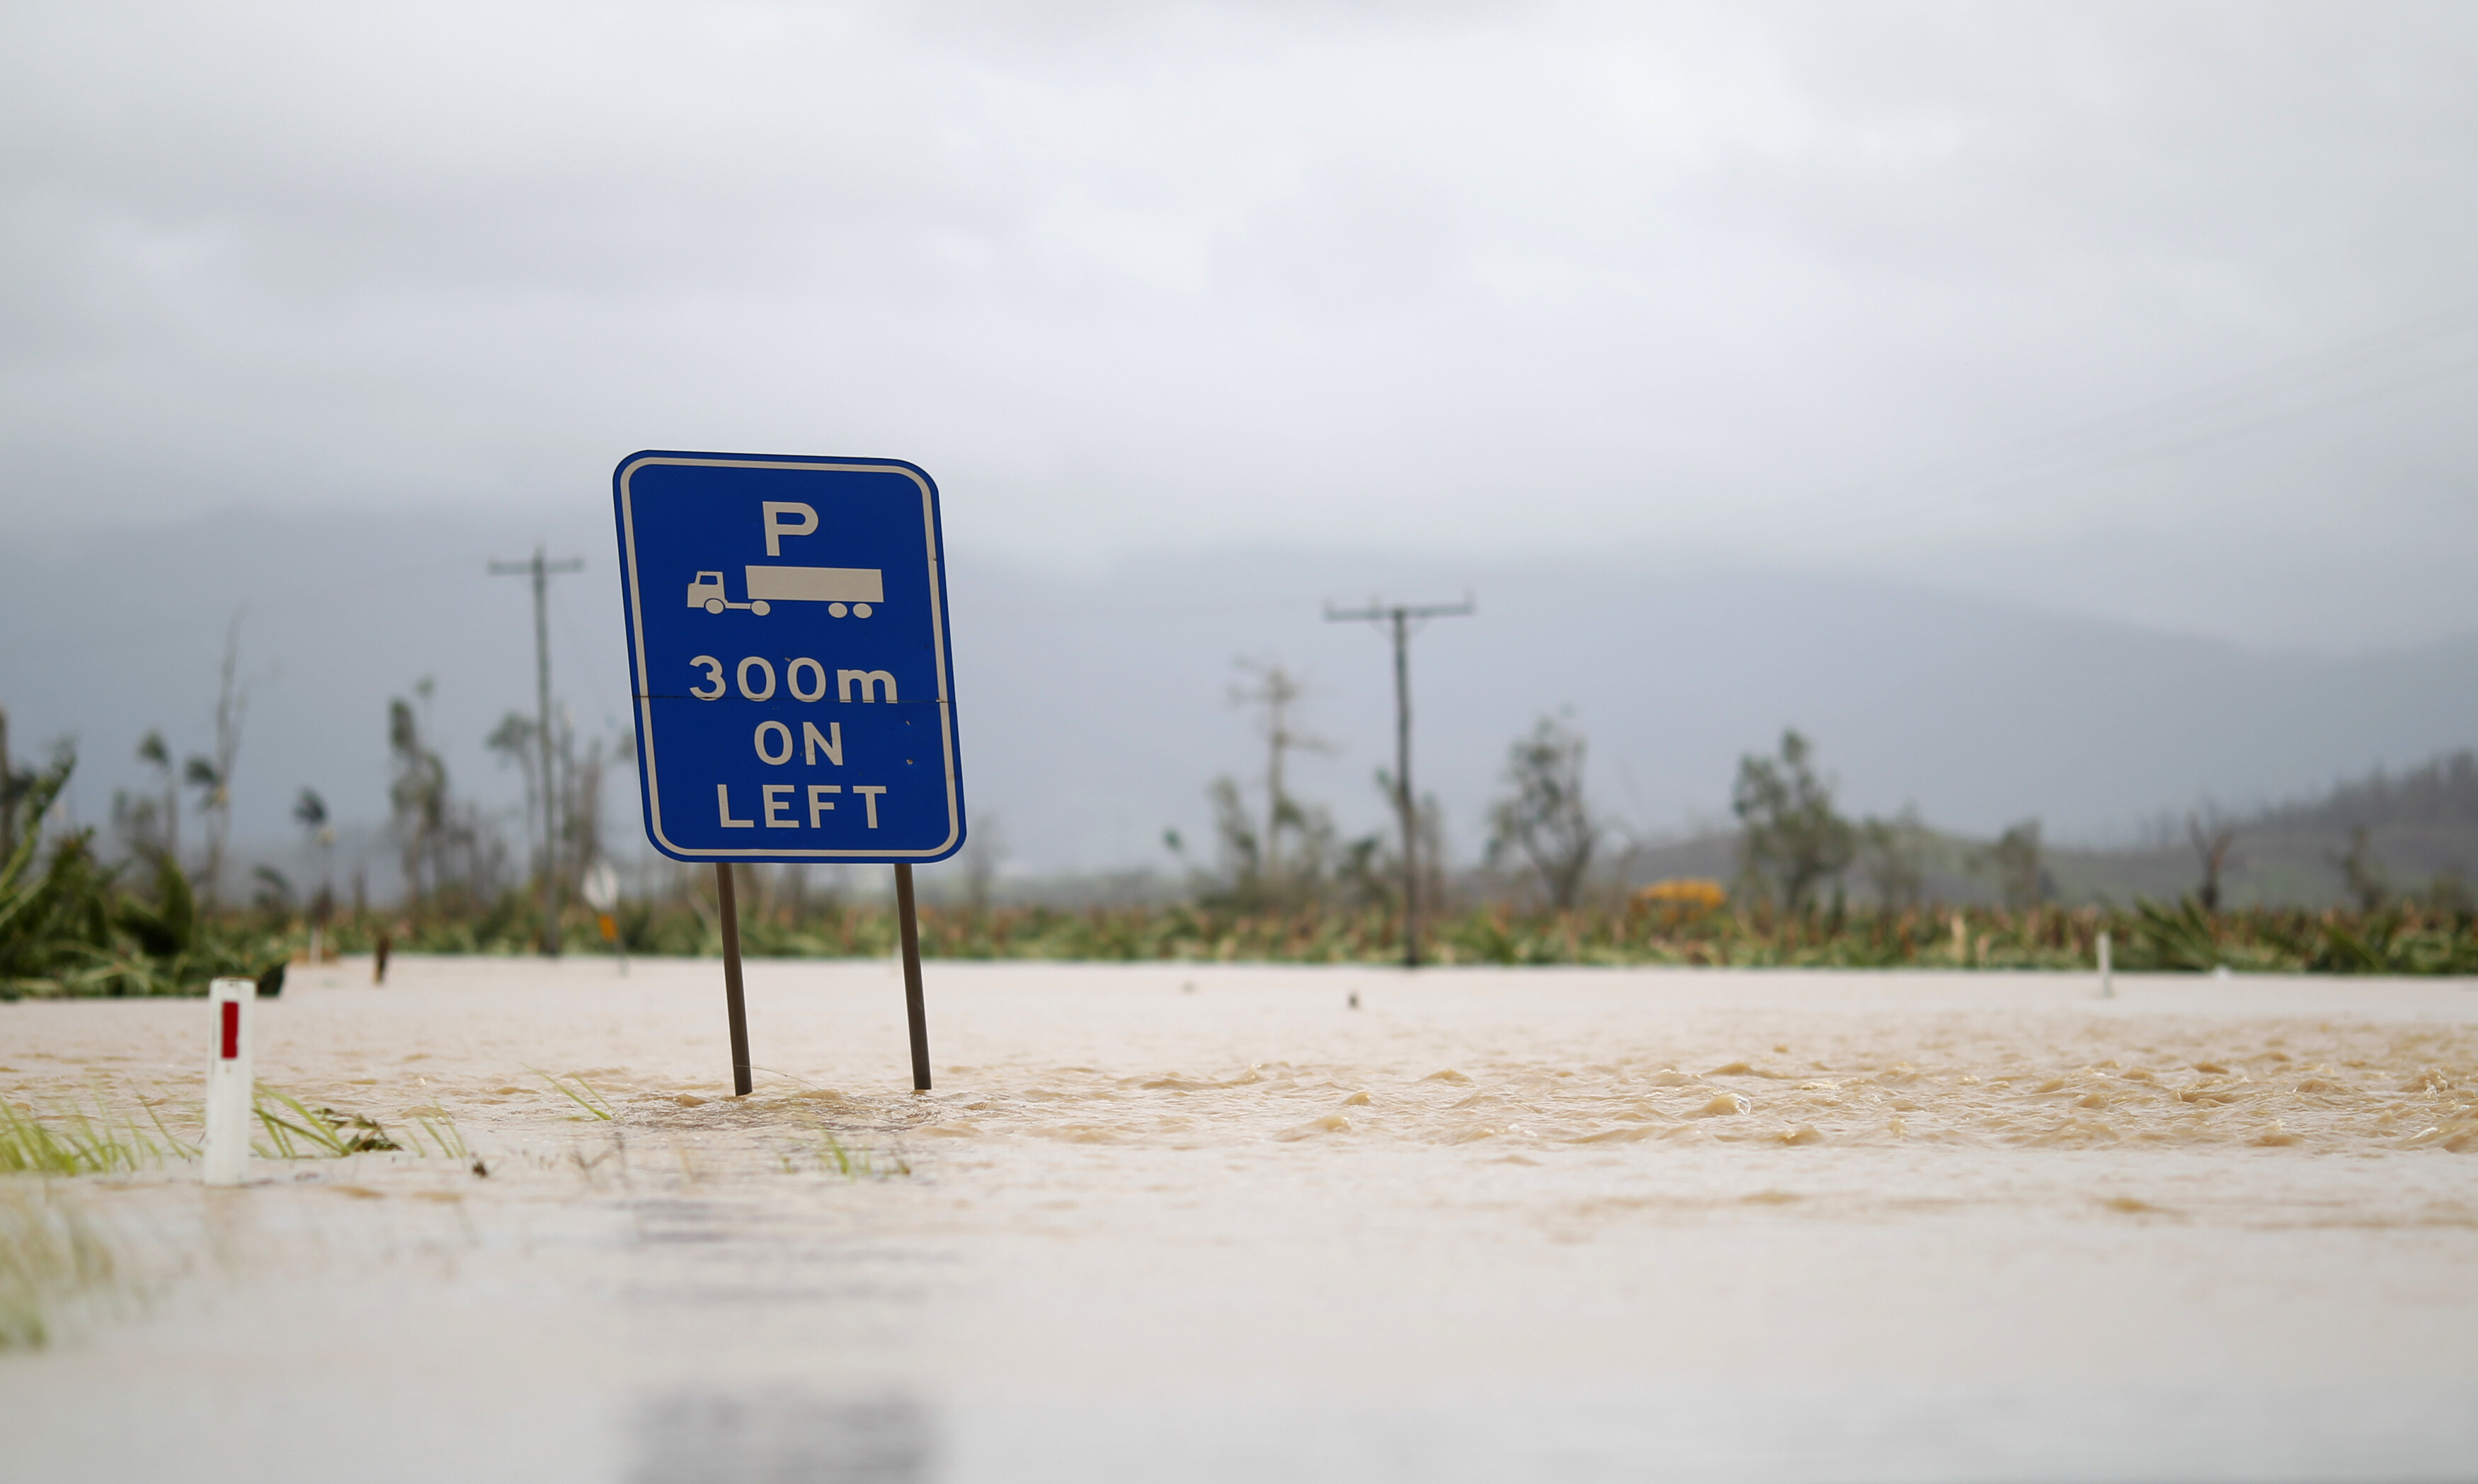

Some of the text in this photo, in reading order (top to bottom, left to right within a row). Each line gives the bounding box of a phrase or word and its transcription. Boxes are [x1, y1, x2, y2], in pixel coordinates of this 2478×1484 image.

[762, 501, 818, 556] P
[689, 655, 898, 704] 300m
[754, 720, 843, 766] ON
[717, 784, 887, 828] LEFT
